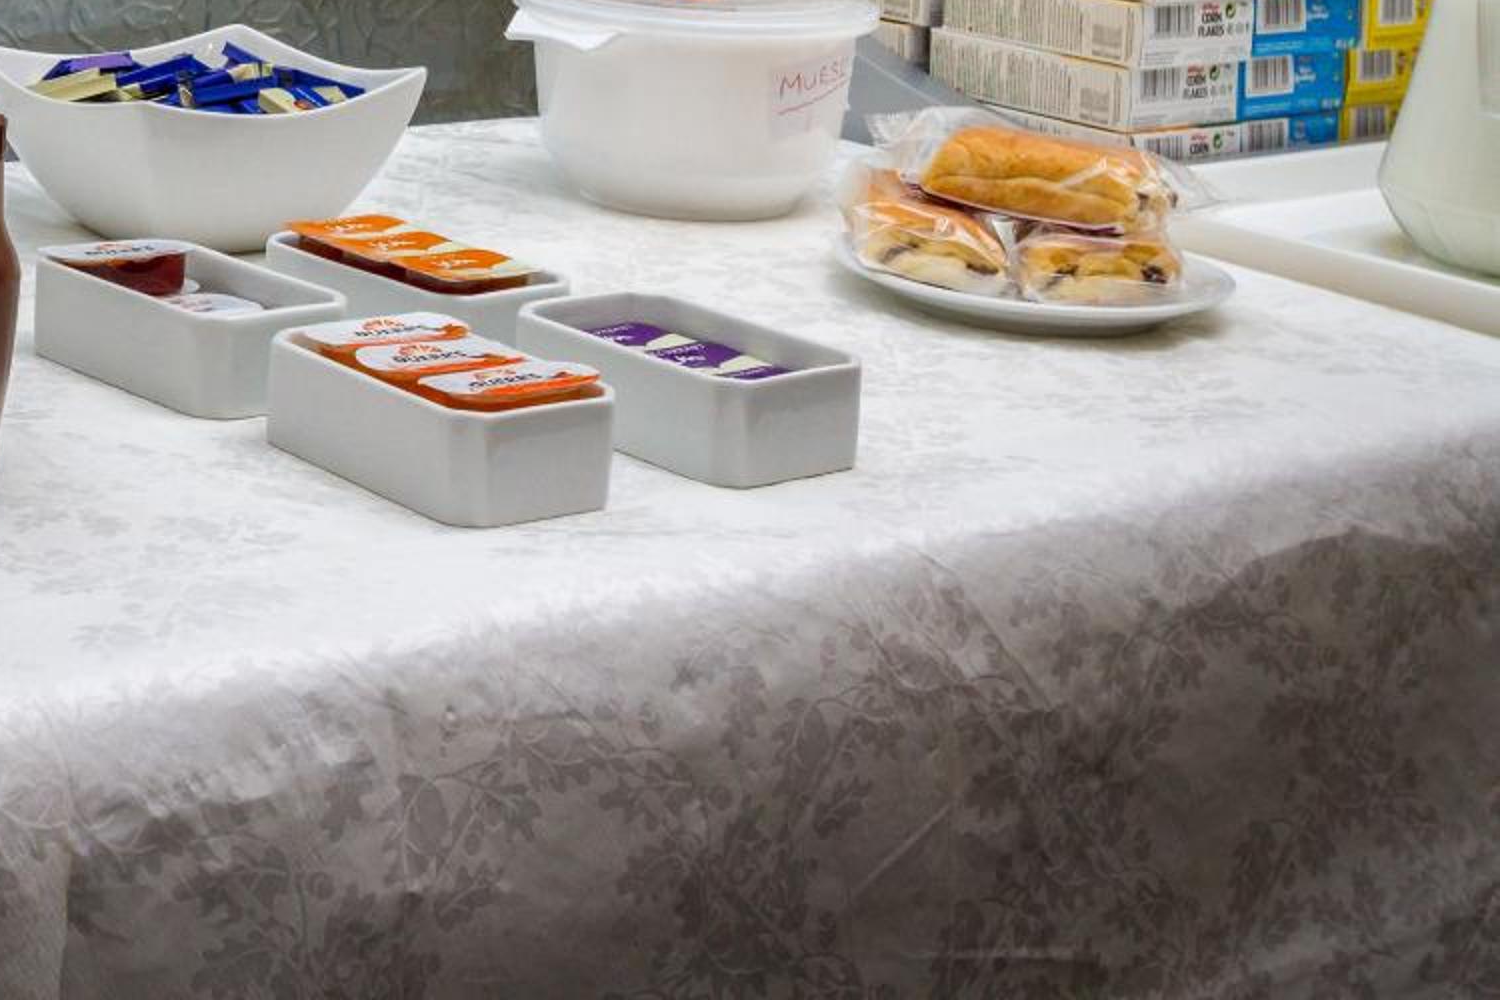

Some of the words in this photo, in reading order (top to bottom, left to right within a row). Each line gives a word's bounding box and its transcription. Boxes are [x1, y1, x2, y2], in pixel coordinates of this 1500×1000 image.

[1201, 13, 1222, 24] CORN
[1198, 25, 1225, 37] FLAKES
[1186, 74, 1207, 86] CORN
[1189, 143, 1210, 154] CORN
